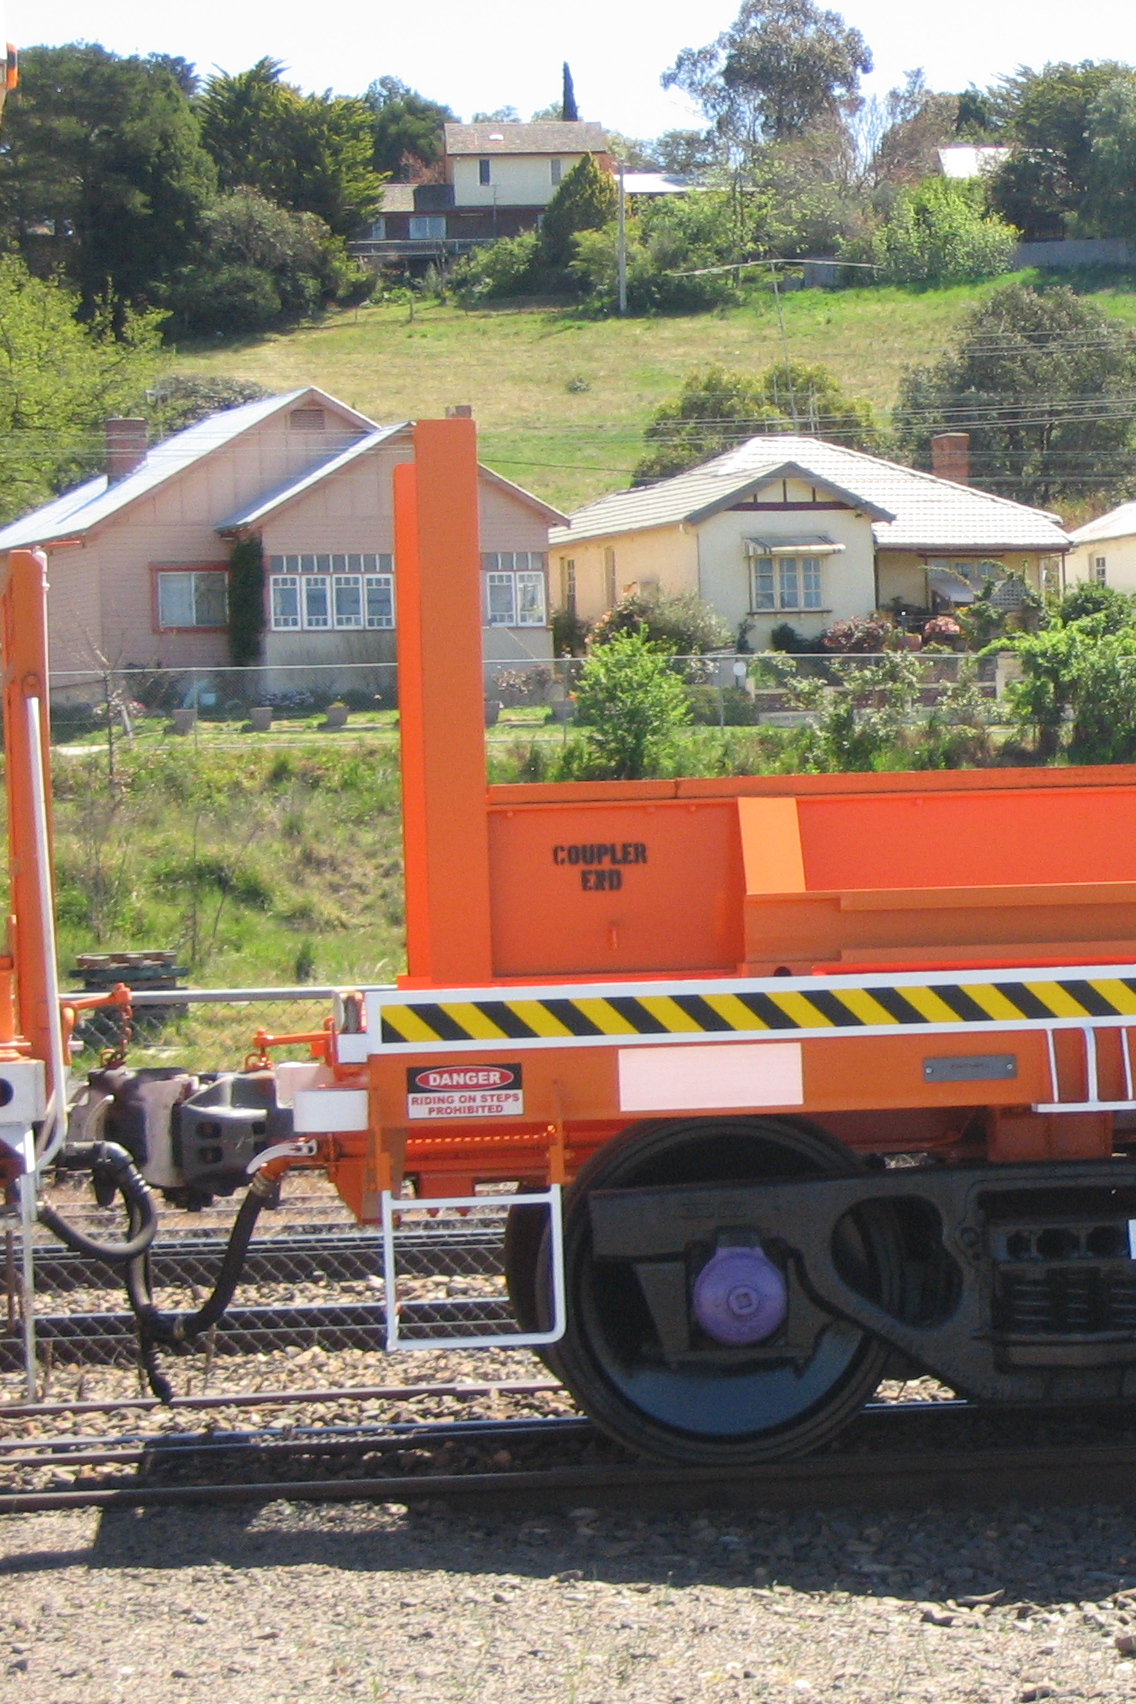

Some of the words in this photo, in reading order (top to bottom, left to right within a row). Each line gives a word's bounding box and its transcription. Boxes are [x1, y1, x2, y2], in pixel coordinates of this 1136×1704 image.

[553, 843, 648, 865] COUPLER
[581, 869, 623, 891] END
[428, 1071, 502, 1086] DANGER
[411, 1095, 455, 1106] RIDING
[458, 1094, 477, 1104] ON
[480, 1093, 520, 1103] STEPS
[428, 1104, 504, 1116] PROHIBITED
